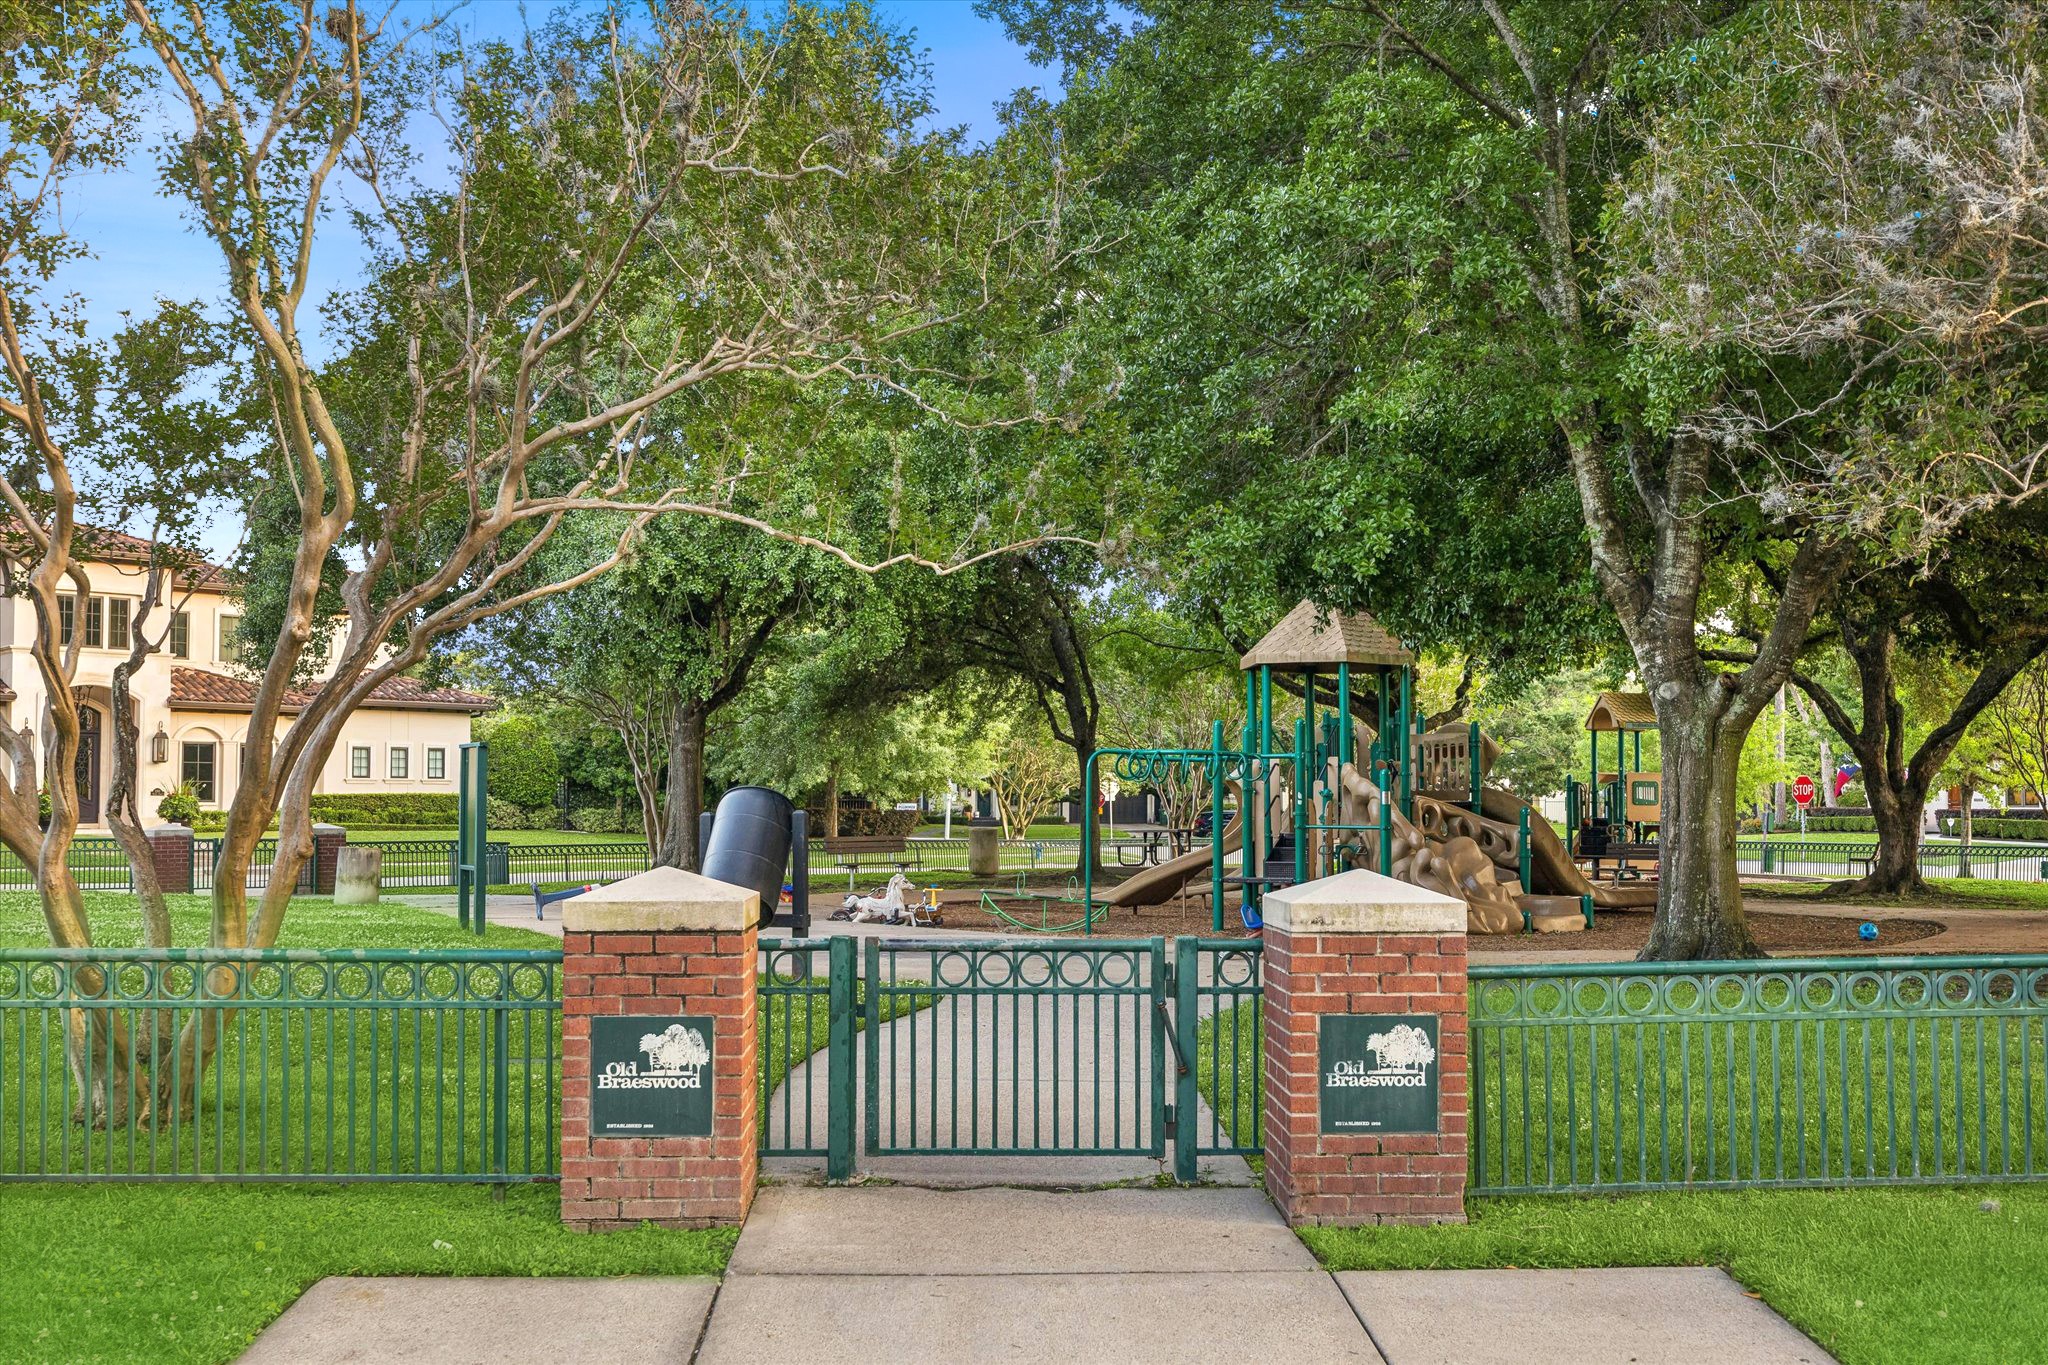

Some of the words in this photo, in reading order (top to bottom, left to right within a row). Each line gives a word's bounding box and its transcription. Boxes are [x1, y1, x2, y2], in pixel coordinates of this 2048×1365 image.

[1793, 784, 1813, 796] STOP
[605, 1061, 638, 1077] Old
[1333, 1060, 1365, 1075] Old
[597, 1074, 701, 1089] Braeswood
[1325, 1072, 1427, 1087] Braeswood
